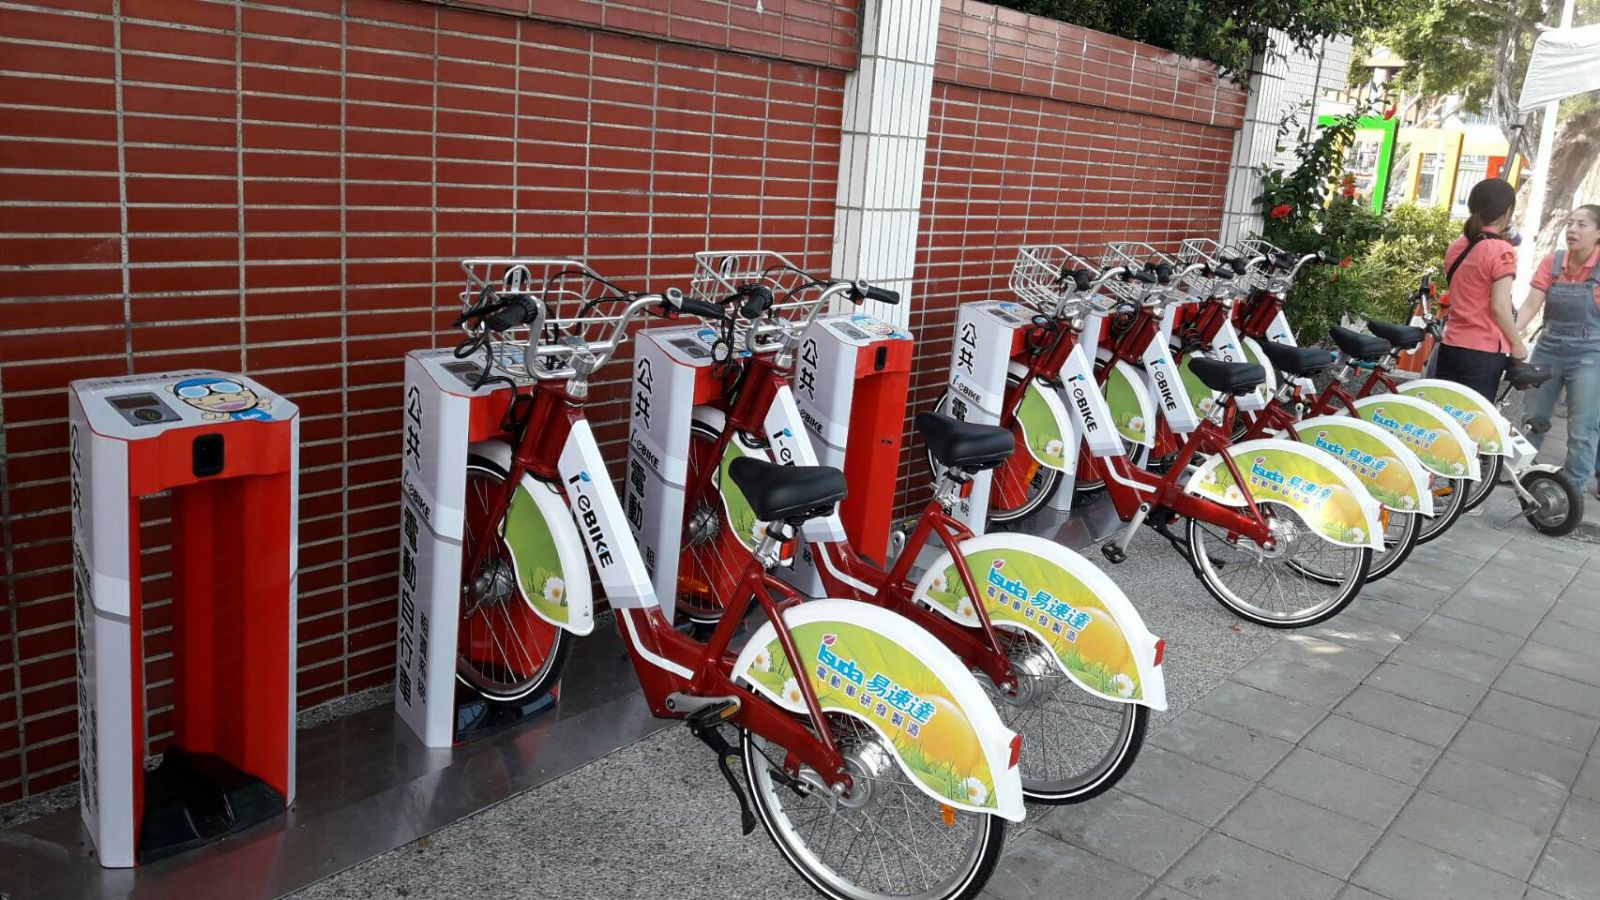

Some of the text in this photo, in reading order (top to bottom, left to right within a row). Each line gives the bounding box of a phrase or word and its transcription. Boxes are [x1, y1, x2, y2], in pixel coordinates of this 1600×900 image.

[799, 337, 819, 400] 公共
[957, 322, 977, 375] 公共
[633, 357, 654, 430] 公共
[1067, 373, 1098, 433] i-eBIKE
[405, 385, 423, 472] 公共
[568, 470, 616, 570] i-eBIKE
[398, 505, 419, 711] 電動自行車
[1030, 590, 1090, 631] 易速達
[866, 673, 935, 724] 易速達
